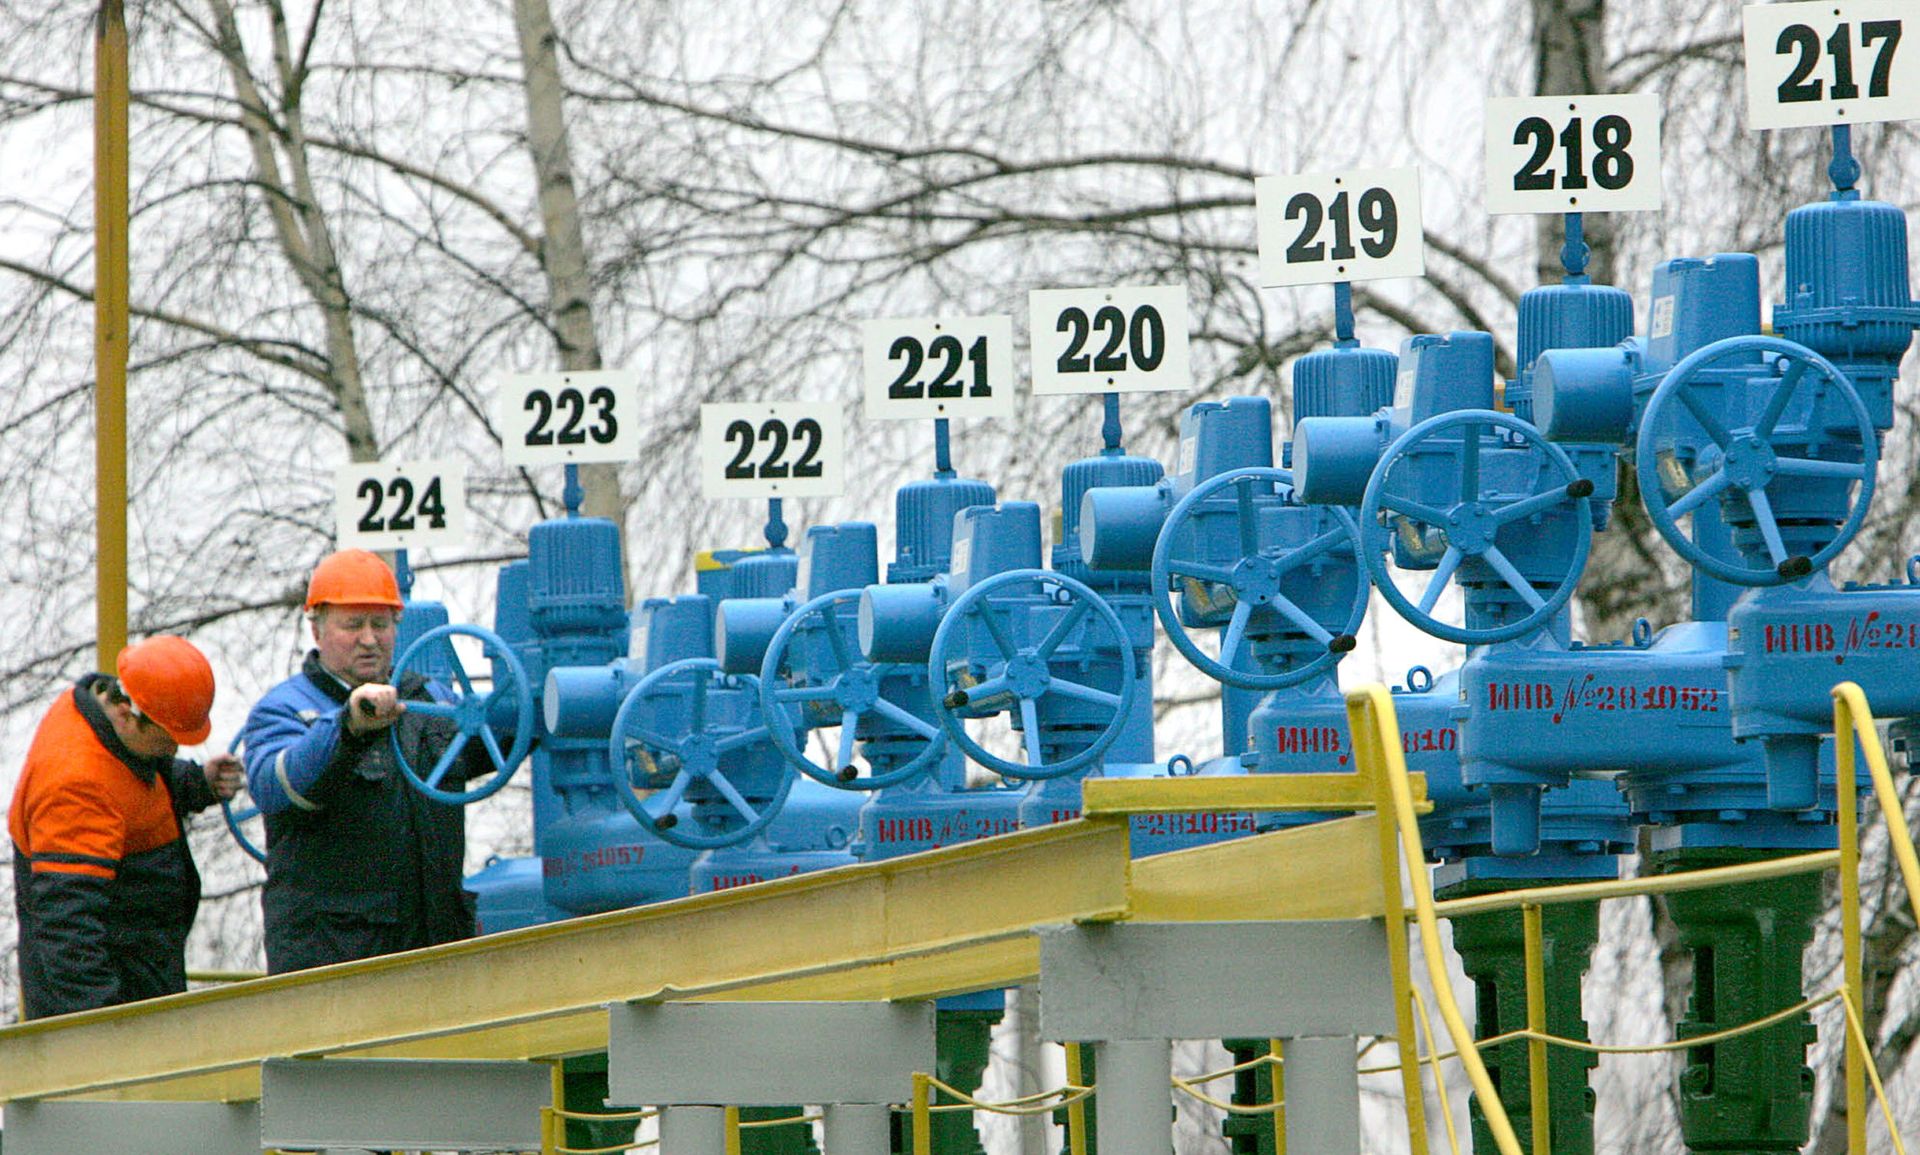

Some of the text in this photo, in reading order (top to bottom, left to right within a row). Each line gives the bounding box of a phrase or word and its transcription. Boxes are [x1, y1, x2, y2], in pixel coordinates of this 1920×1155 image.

[1776, 19, 1902, 104] 217
[1513, 115, 1634, 190] 218
[1284, 187, 1398, 263] 219
[888, 335, 992, 399] 221
[1056, 305, 1165, 373] 220
[524, 387, 618, 446] 223
[725, 418, 823, 480] 222
[357, 477, 446, 531] 224
[1765, 624, 1835, 653] ИНВ
[1489, 682, 1553, 711] ИНВ
[1278, 726, 1340, 753] ИНВ
